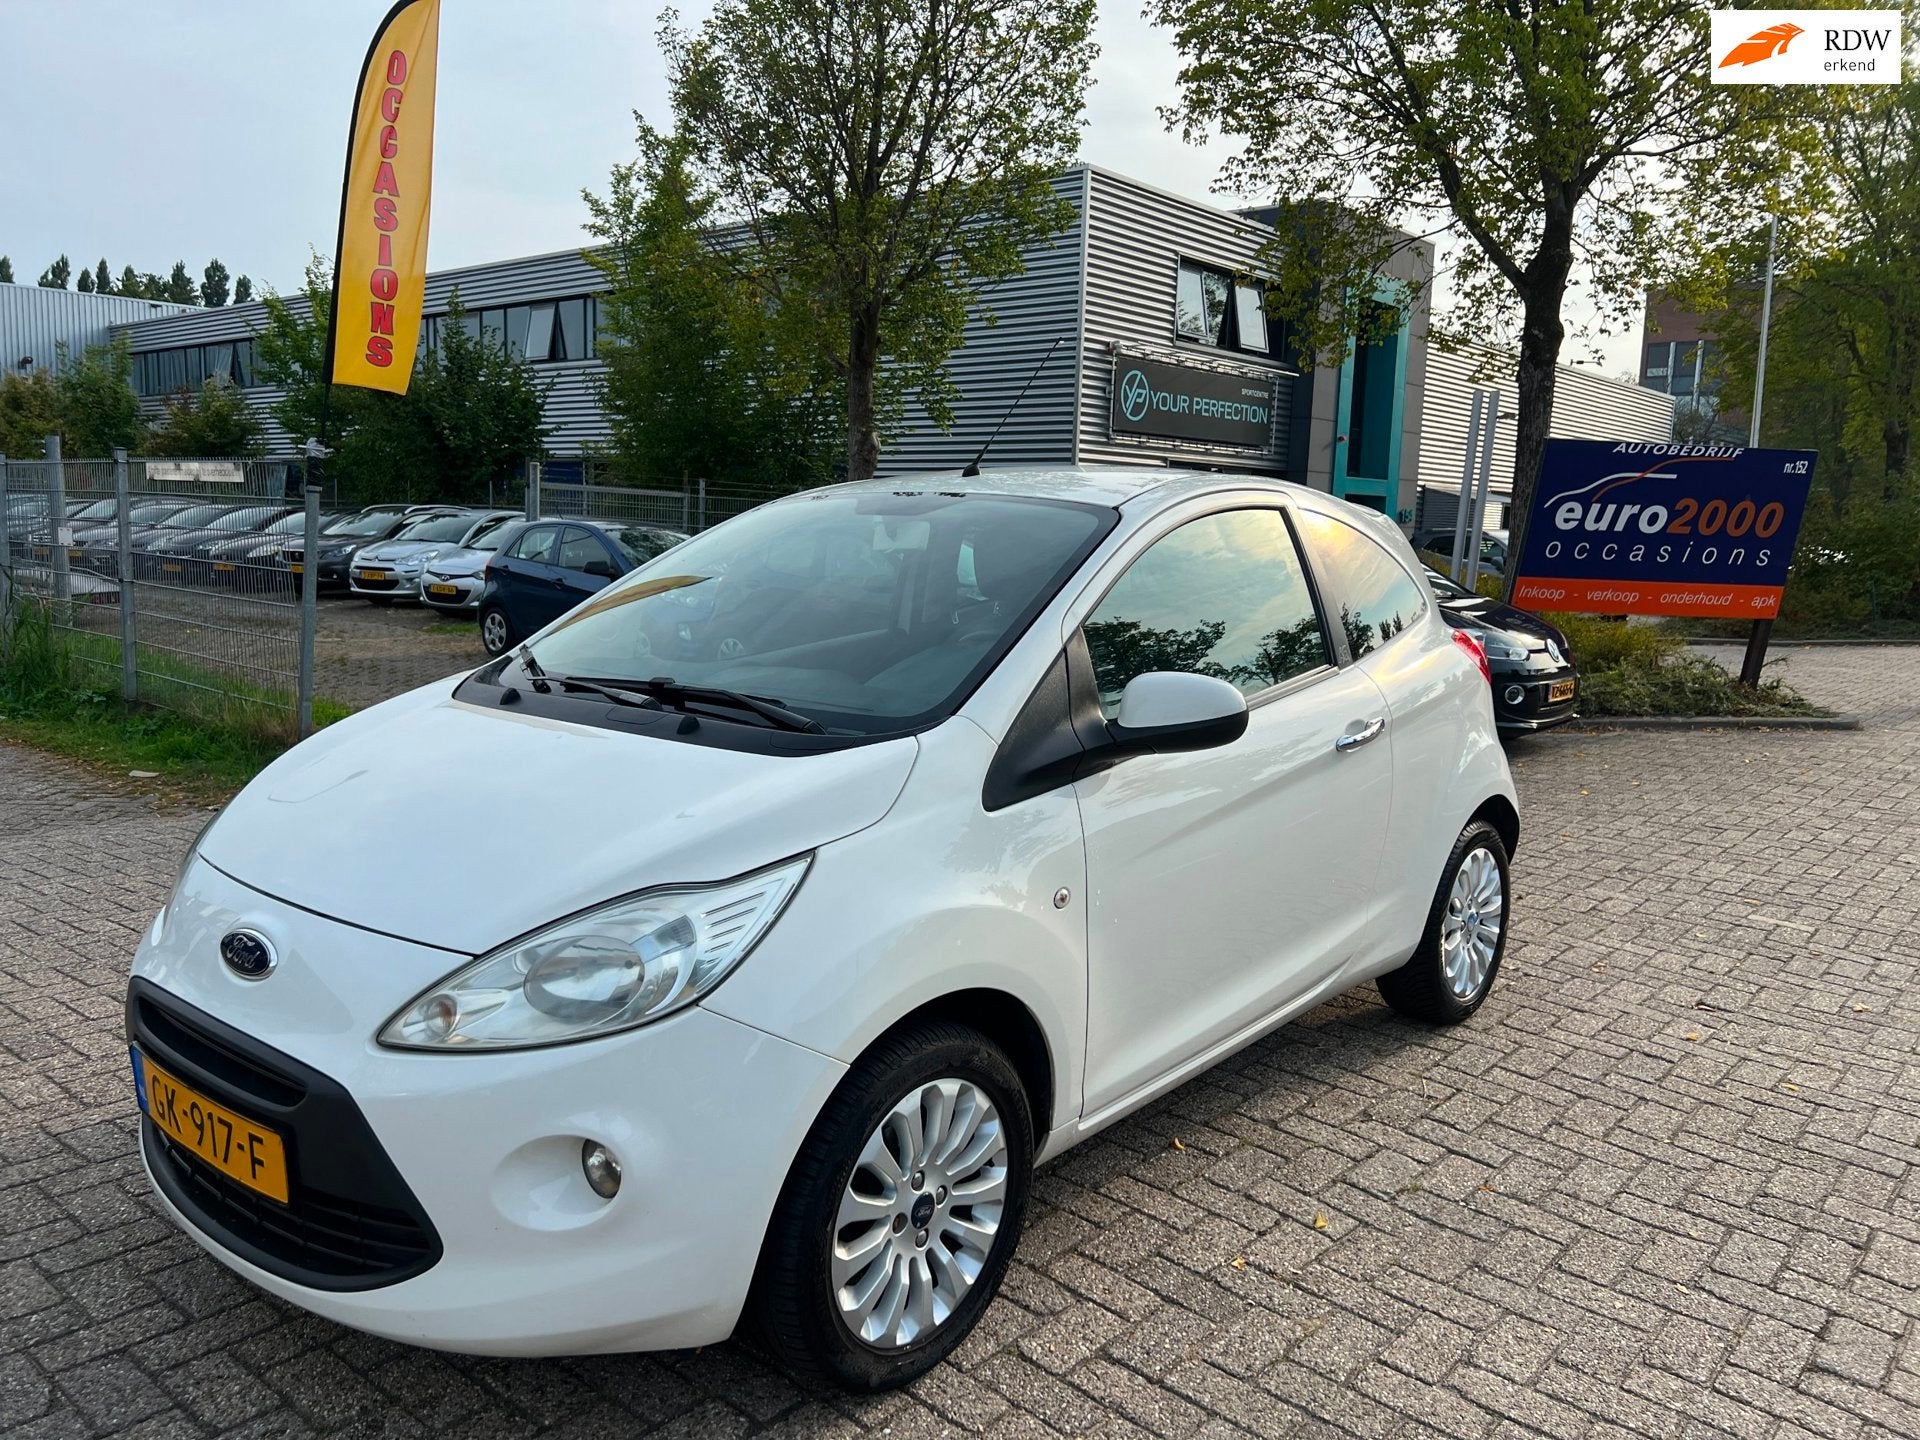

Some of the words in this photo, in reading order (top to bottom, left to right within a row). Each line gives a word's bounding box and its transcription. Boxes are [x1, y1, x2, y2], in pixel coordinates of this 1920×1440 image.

[365, 49, 408, 368] OCCASIONS
[1150, 390, 1190, 415] YOUR
[1193, 396, 1268, 425] PERFECTION
[1612, 441, 1744, 458] AUTOBEDRIJF
[1783, 460, 1809, 475] nr.152
[1554, 497, 1785, 538] euro2000
[1545, 540, 1771, 567] occasions
[1518, 584, 1566, 601] Inkoop
[1586, 588, 1640, 603] verkoop
[1659, 591, 1734, 606] onderhoud
[1750, 594, 1777, 608] apk
[226, 934, 261, 969] Ford
[151, 1074, 265, 1180] GK-917-F
